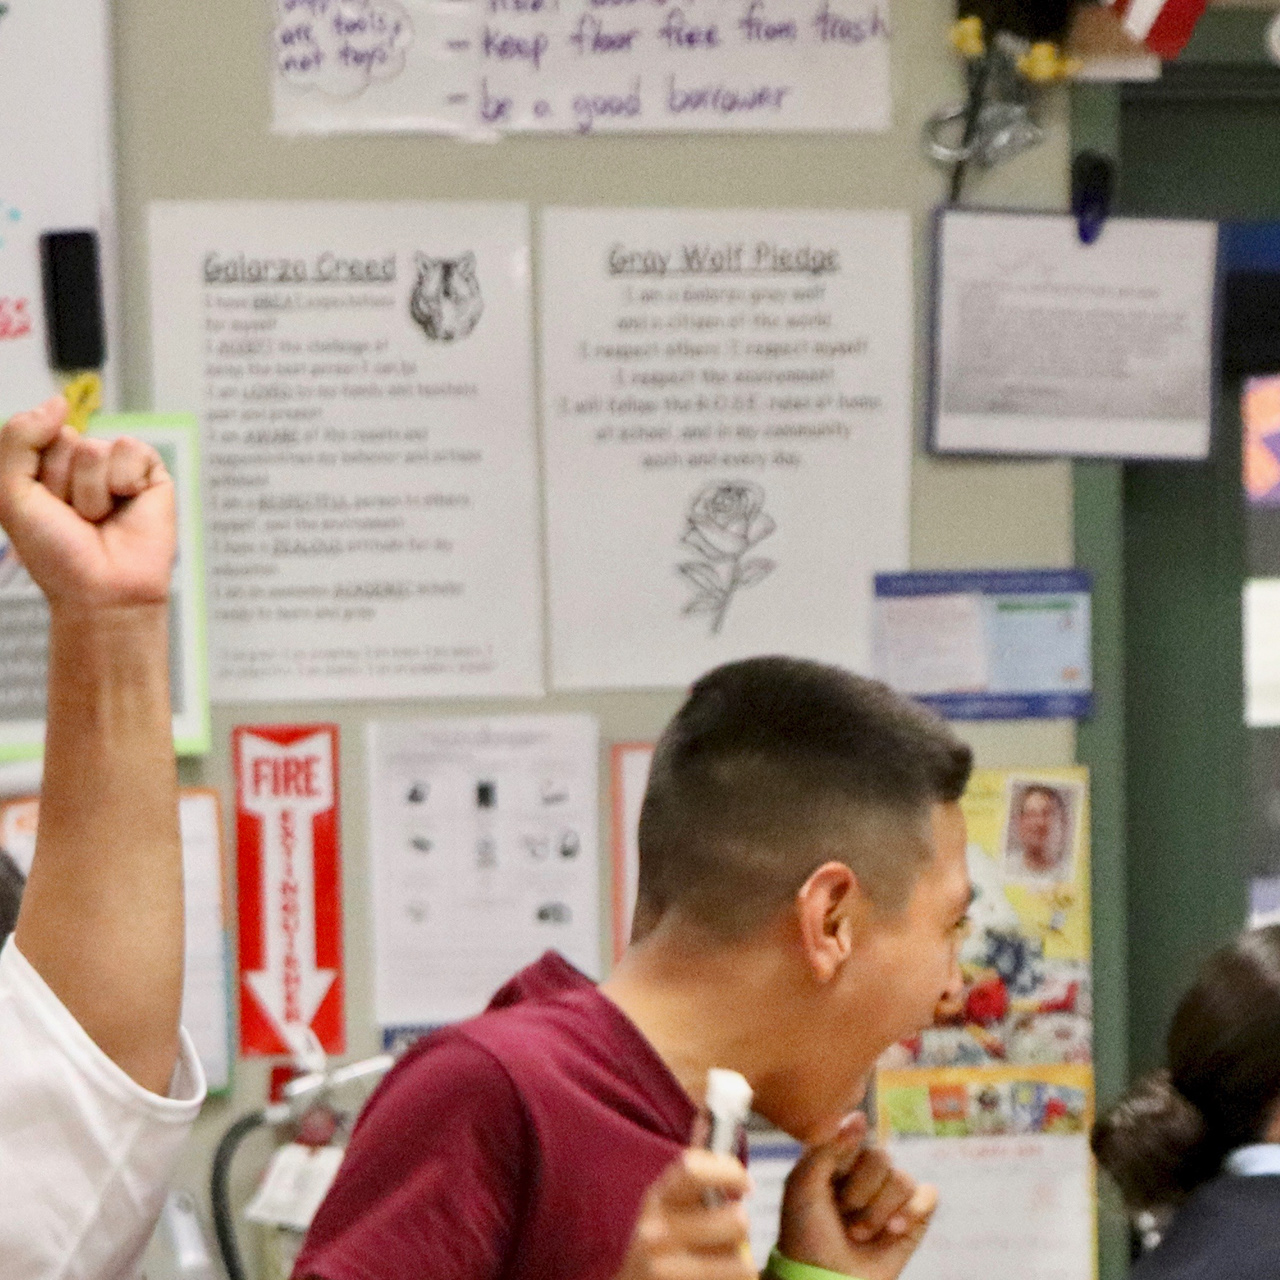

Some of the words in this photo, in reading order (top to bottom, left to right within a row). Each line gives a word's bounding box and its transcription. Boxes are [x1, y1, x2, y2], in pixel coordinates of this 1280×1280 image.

[573, 79, 642, 134] good
[204, 250, 307, 282] Galarza
[313, 250, 397, 282] Creed
[608, 242, 671, 277] Gray
[682, 241, 745, 273] Wolf
[753, 241, 842, 276] Pledge
[252, 754, 322, 799] FIRE
[278, 808, 302, 1024] EXTINGUISHER
